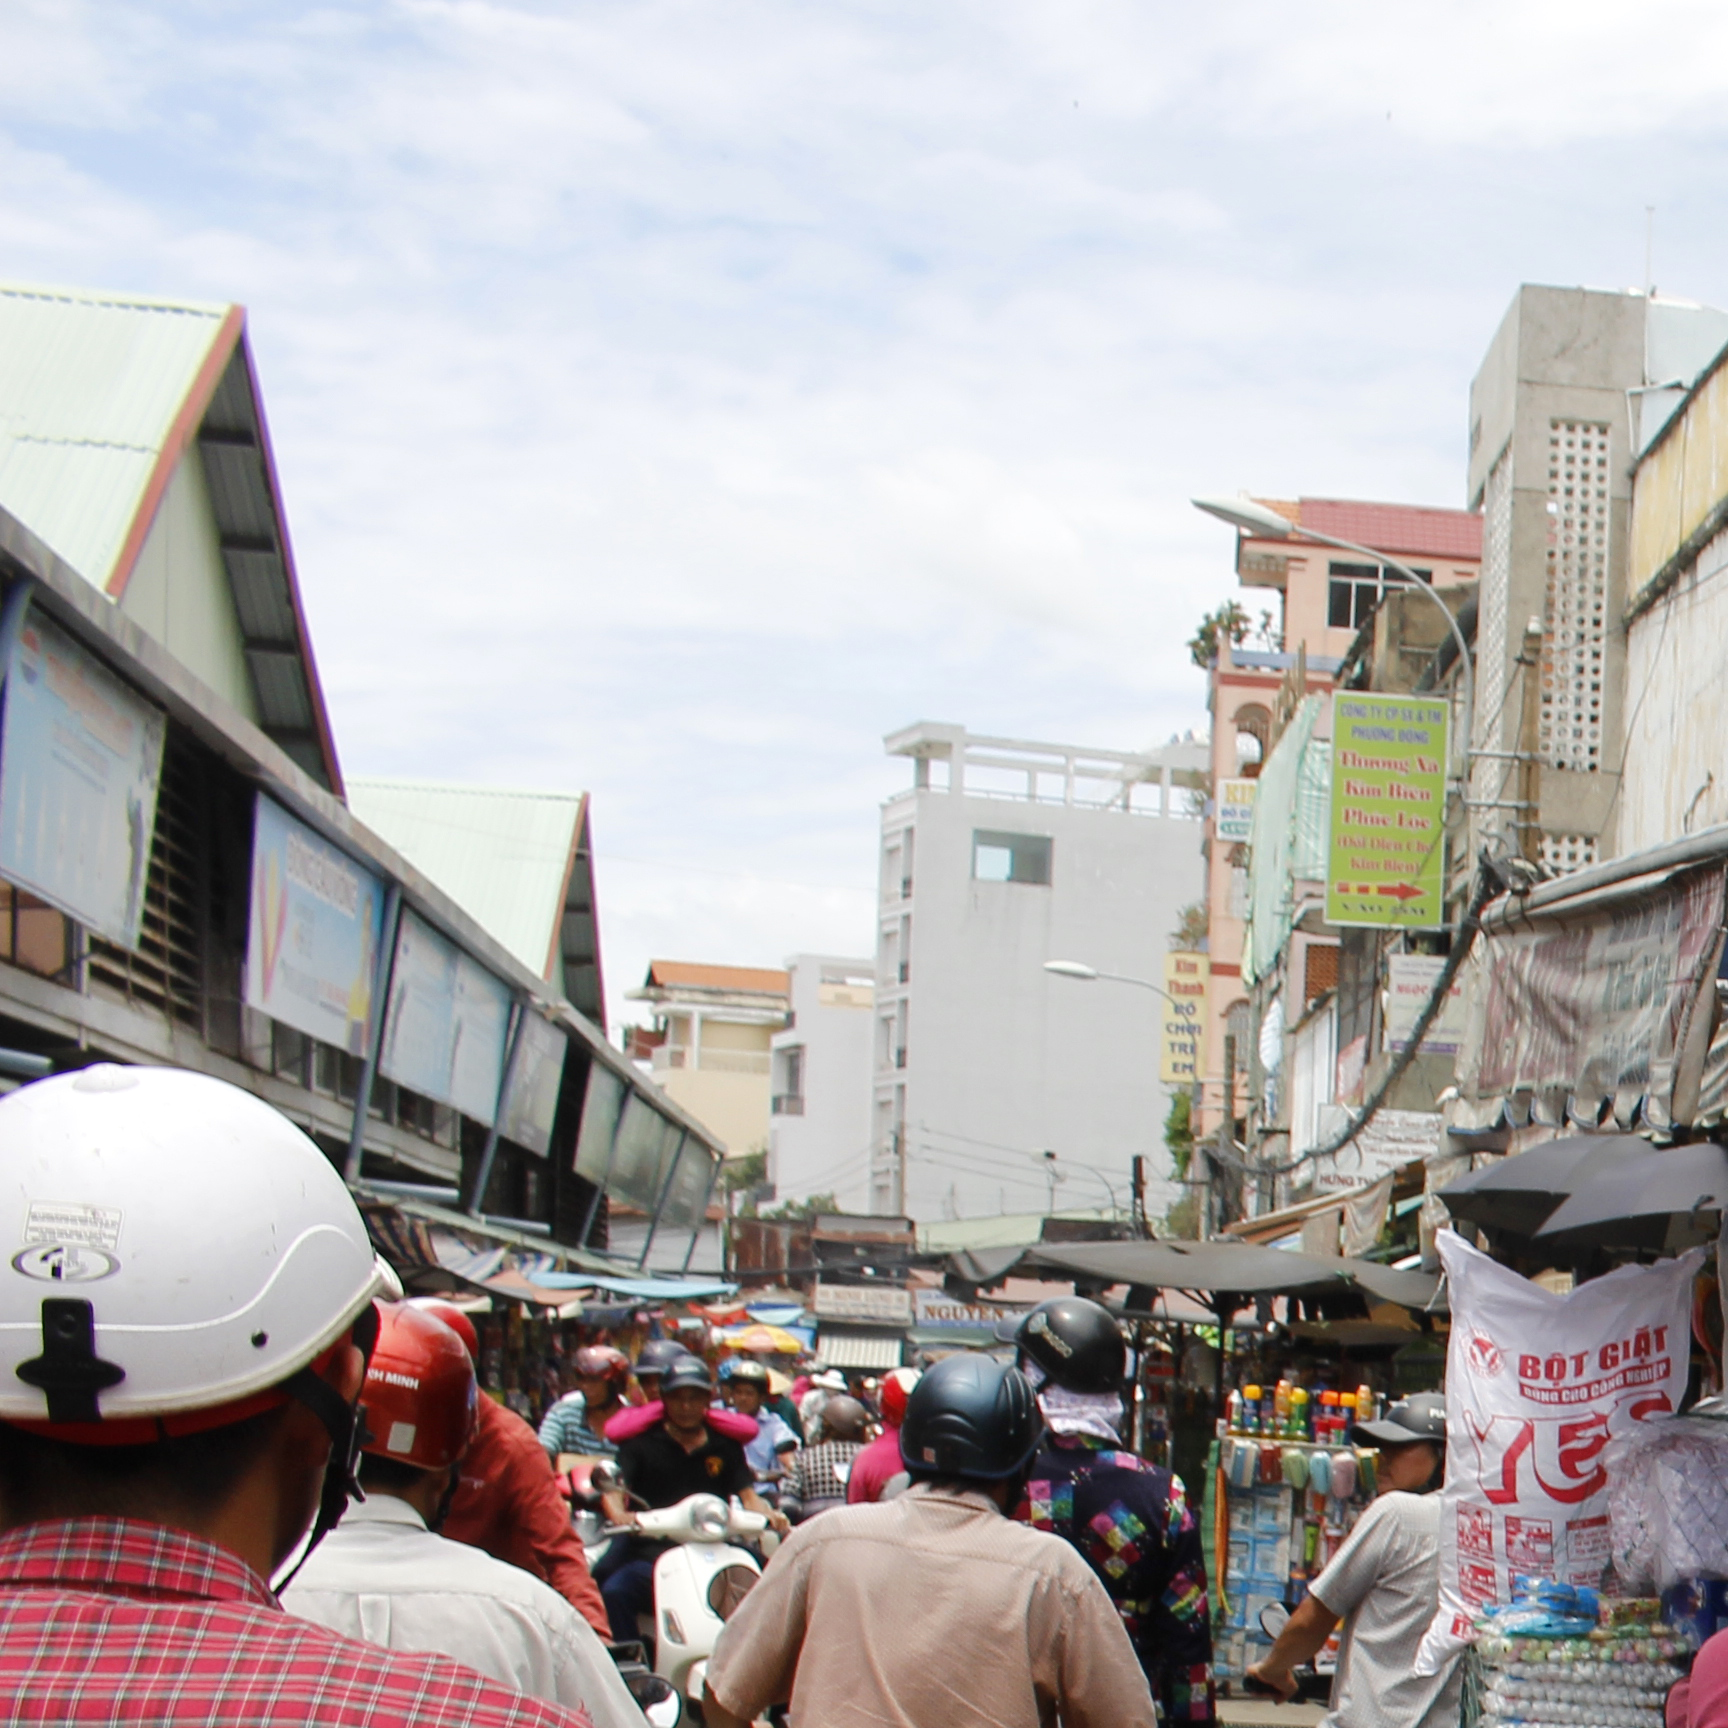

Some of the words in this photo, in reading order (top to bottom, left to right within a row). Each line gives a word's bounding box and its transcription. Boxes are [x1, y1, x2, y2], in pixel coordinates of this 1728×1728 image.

[1344, 780, 1381, 798] Kim
[1518, 1350, 1588, 1388] BỘT
[1599, 1325, 1669, 1371] GIẶT
